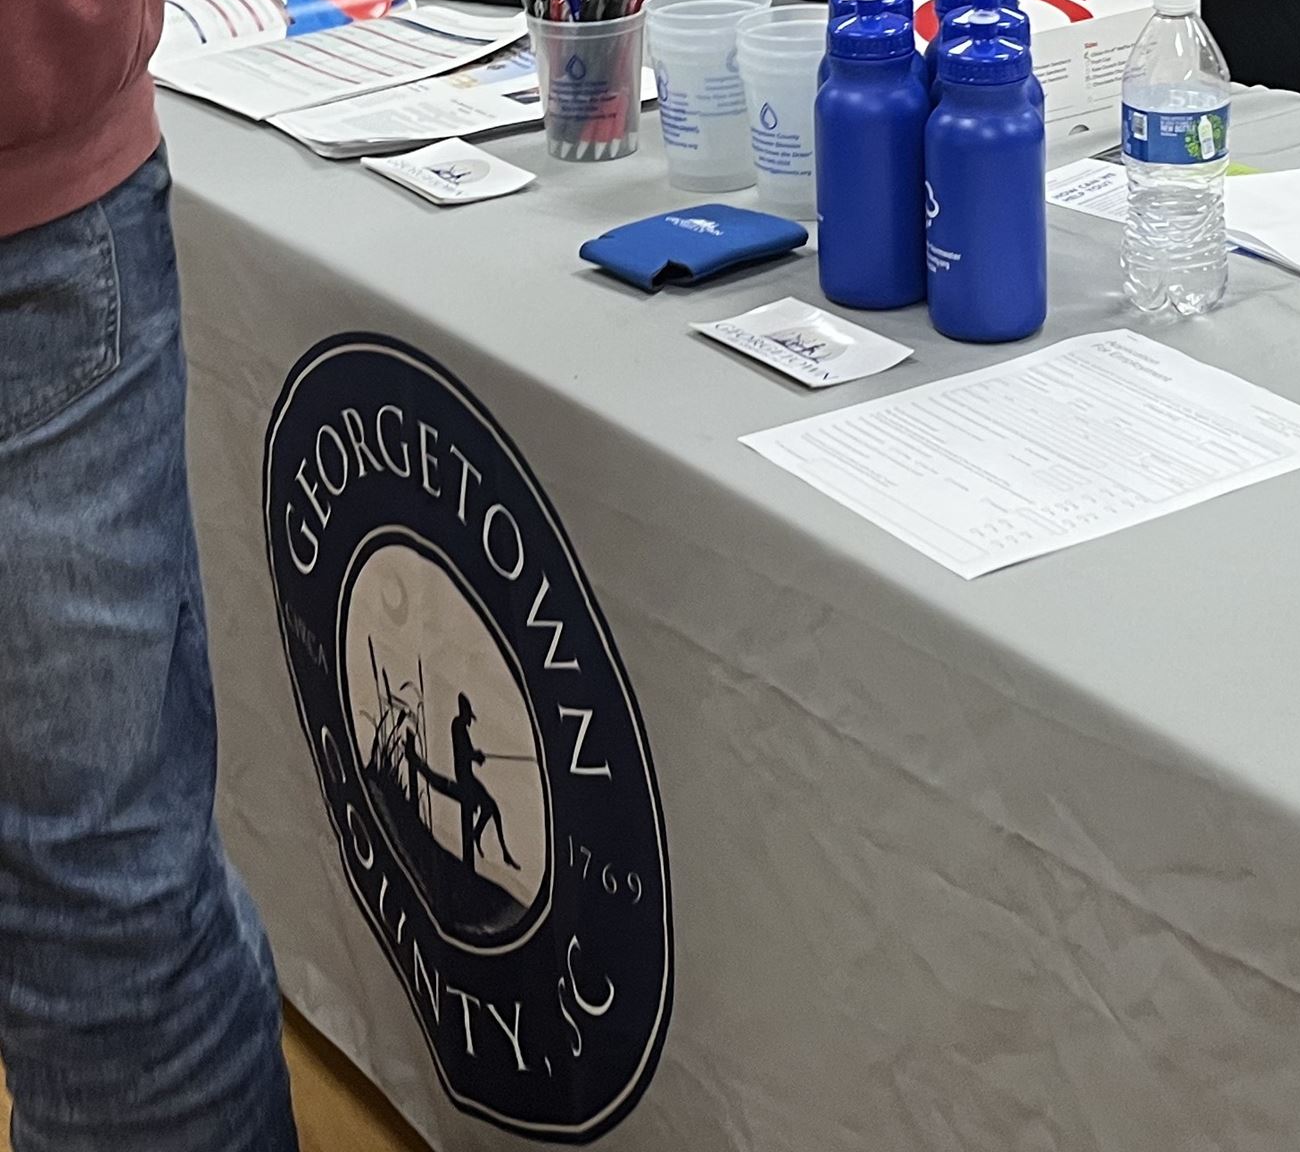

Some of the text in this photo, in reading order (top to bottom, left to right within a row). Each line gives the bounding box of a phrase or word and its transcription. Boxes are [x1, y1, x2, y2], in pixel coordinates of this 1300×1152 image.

[286, 408, 612, 779] GEORGETOWN
[568, 835, 643, 905] 1769
[558, 934, 615, 1057] SC
